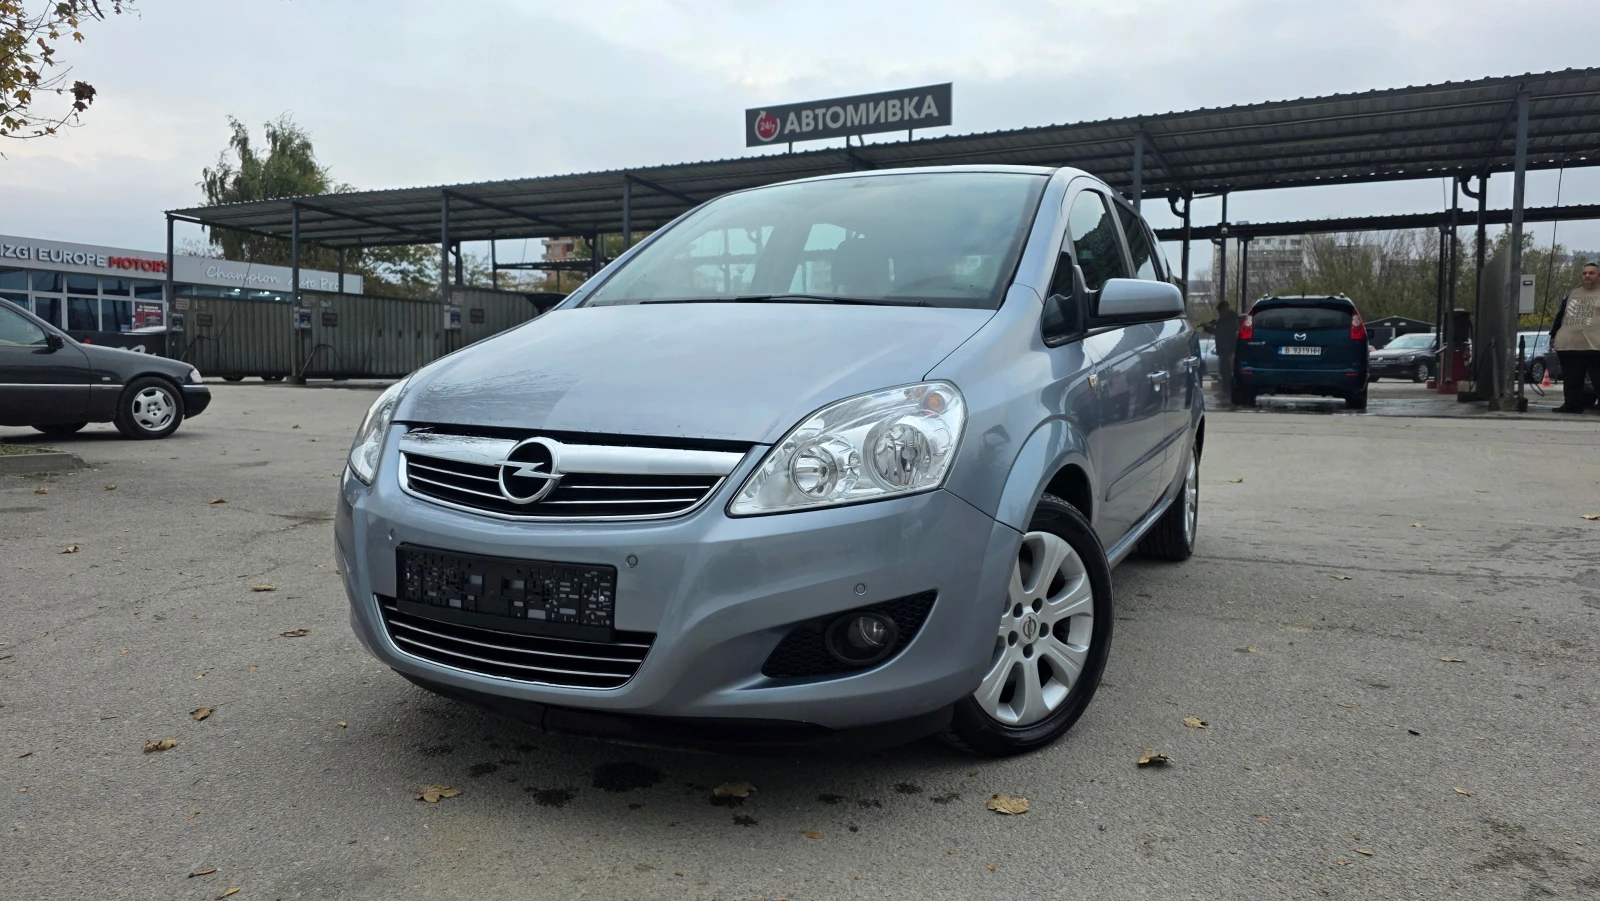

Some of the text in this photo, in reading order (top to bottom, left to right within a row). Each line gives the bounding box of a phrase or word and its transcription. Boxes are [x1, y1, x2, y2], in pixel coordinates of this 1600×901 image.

[760, 95, 938, 134] 24/7 АВТОМИВКА
[38, 247, 107, 267] EUROPE
[206, 266, 280, 284] Champion
